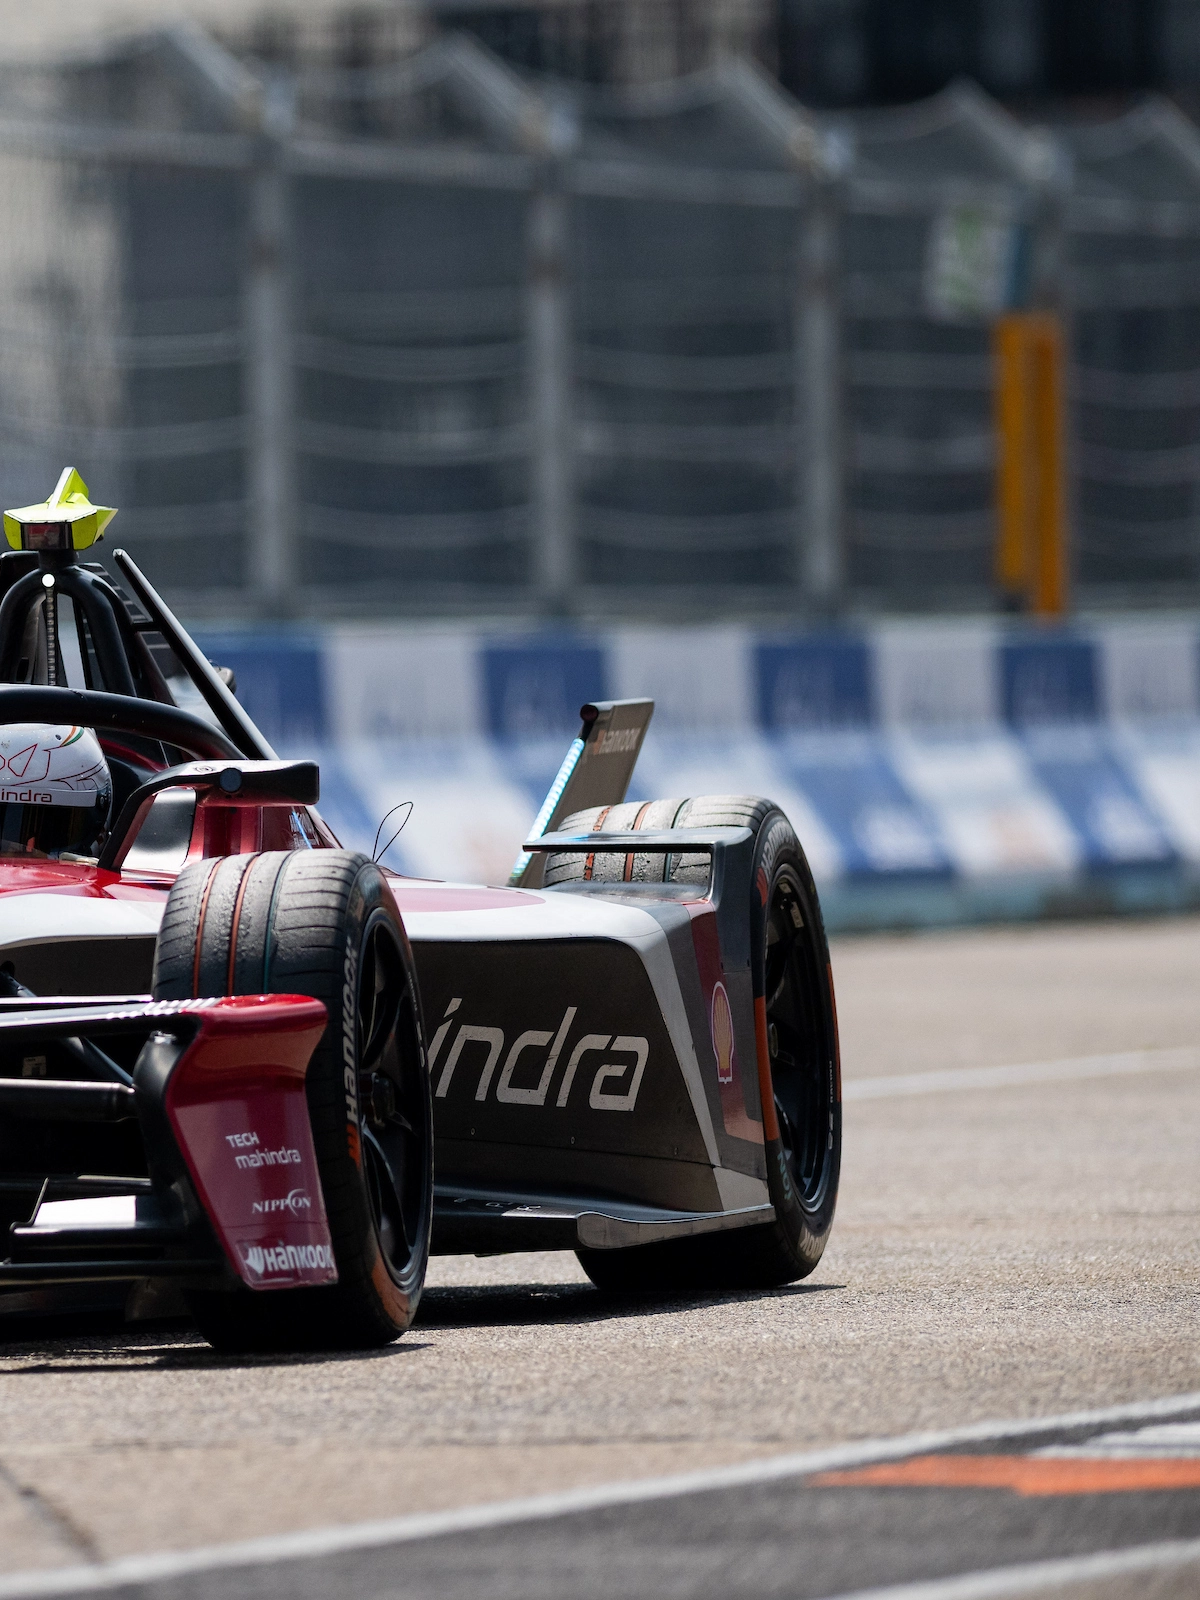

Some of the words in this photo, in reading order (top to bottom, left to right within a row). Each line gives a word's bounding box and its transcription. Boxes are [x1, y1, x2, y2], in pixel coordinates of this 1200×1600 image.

[426, 998, 650, 1112] indra
[225, 1131, 260, 1148] TECH
[234, 1146, 302, 1169] mahindra
[251, 1190, 312, 1216] NIPPON
